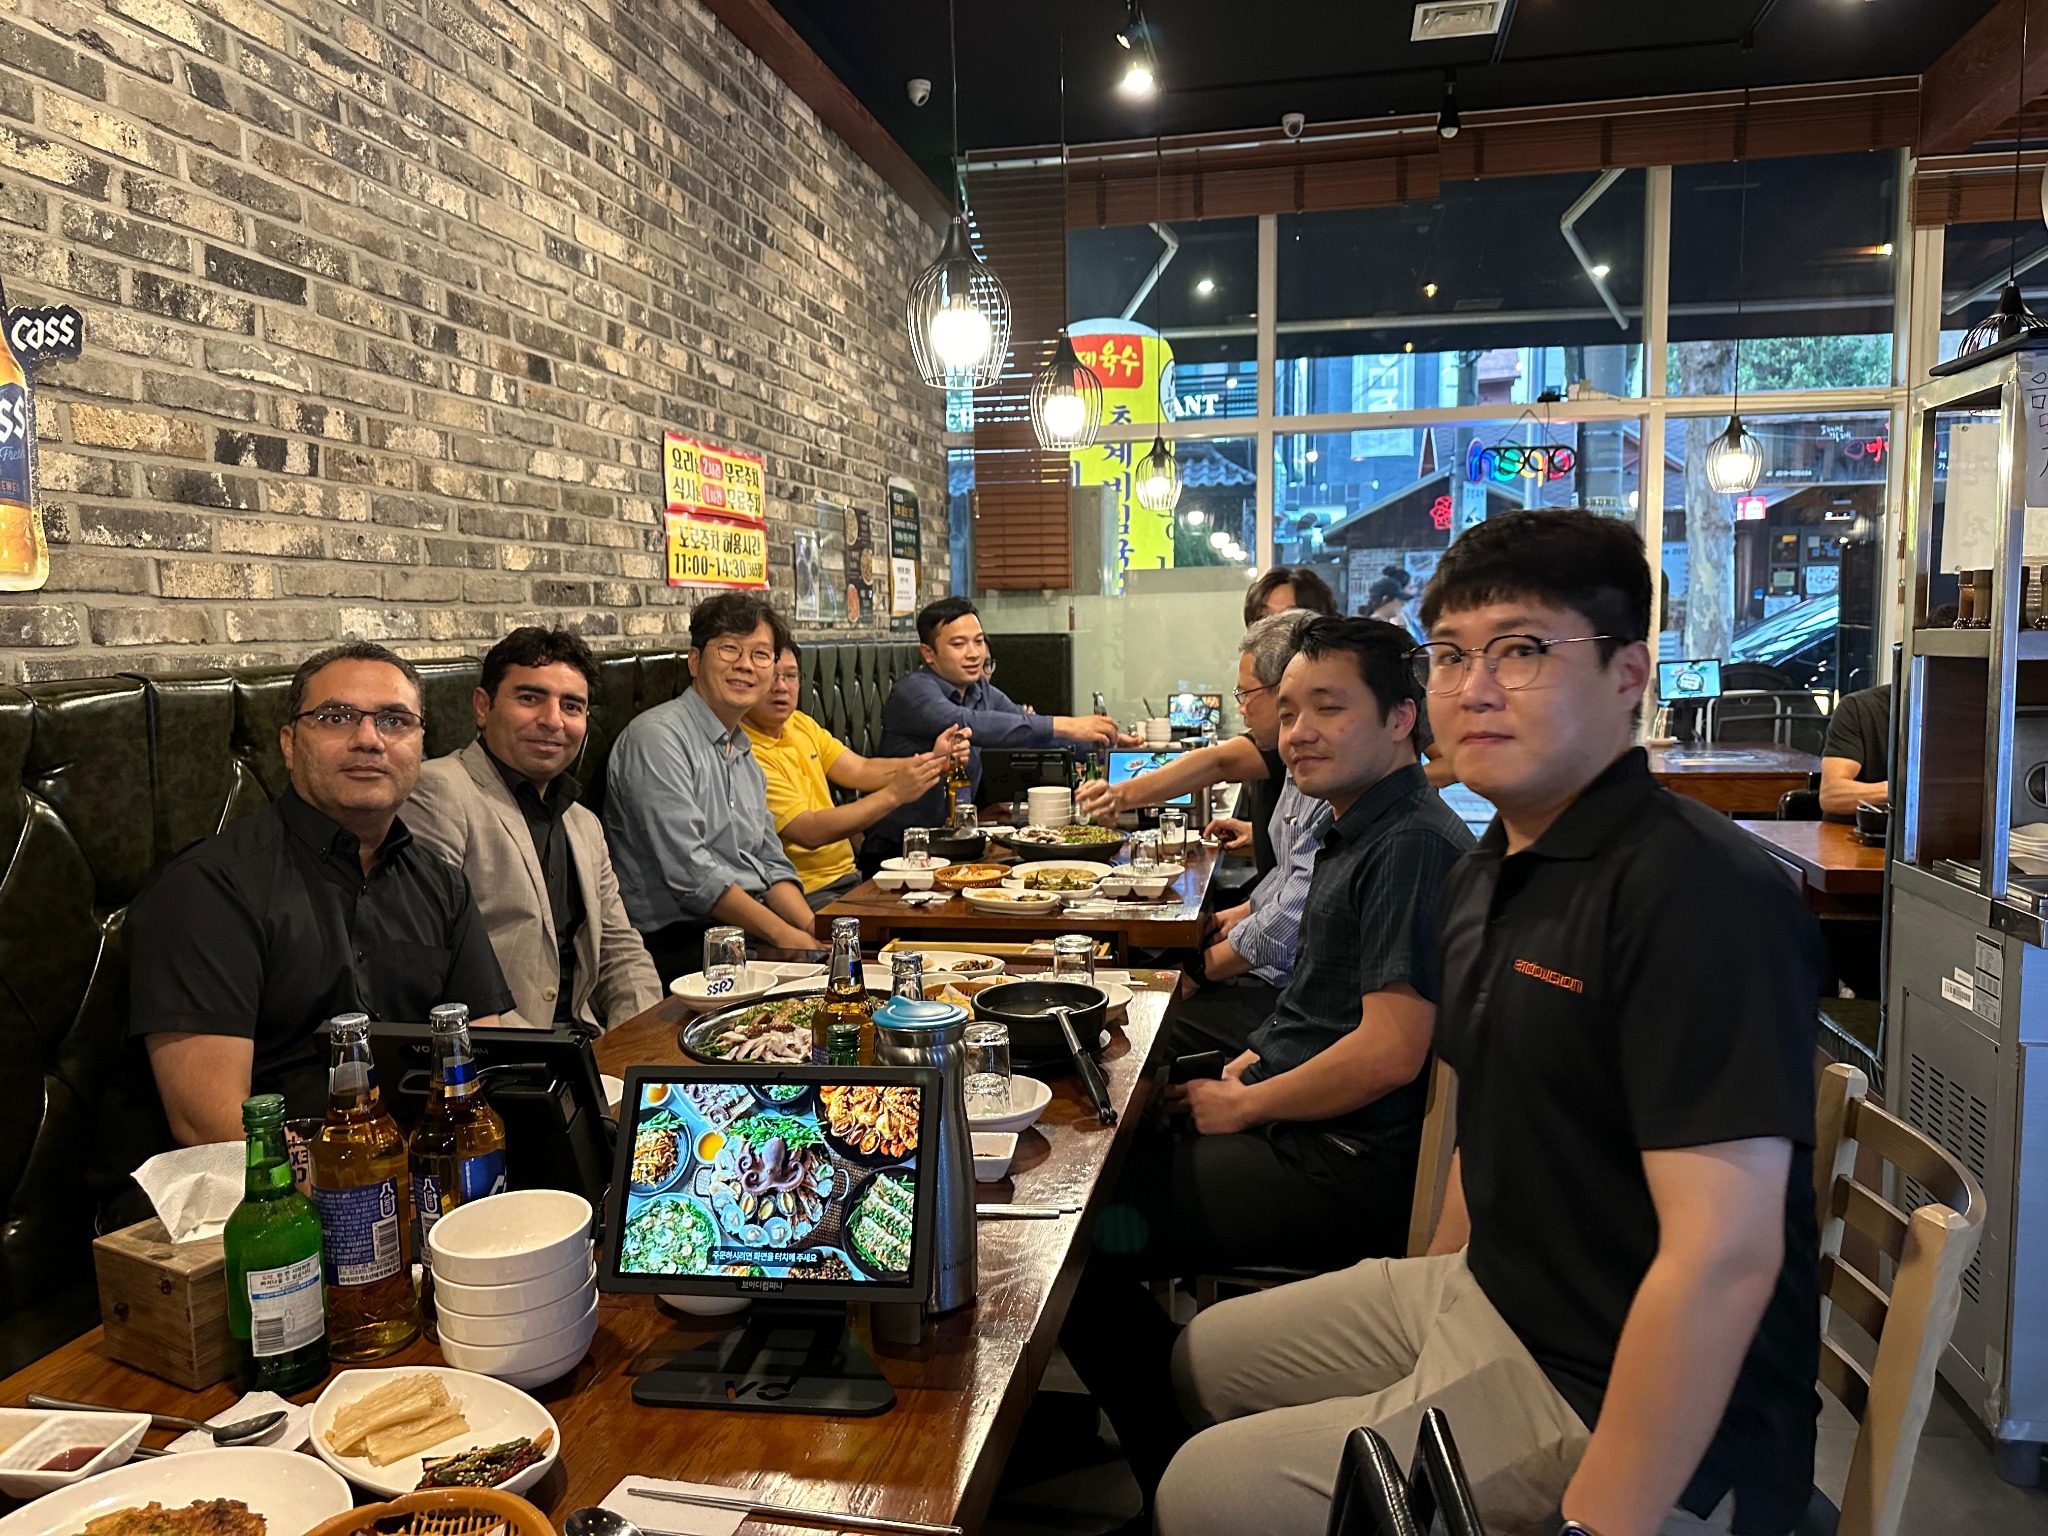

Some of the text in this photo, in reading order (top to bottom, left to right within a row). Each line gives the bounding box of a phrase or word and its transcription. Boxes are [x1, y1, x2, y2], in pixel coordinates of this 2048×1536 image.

[672, 447, 700, 474] 요리는
[725, 462, 760, 489] 무료주차
[673, 476, 702, 503] 식사는
[727, 488, 761, 514] 무료주차
[679, 525, 762, 557] 도로주차 허용시간
[712, 1250, 818, 1263] 주문하시려면 화면을 터치해 주세요
